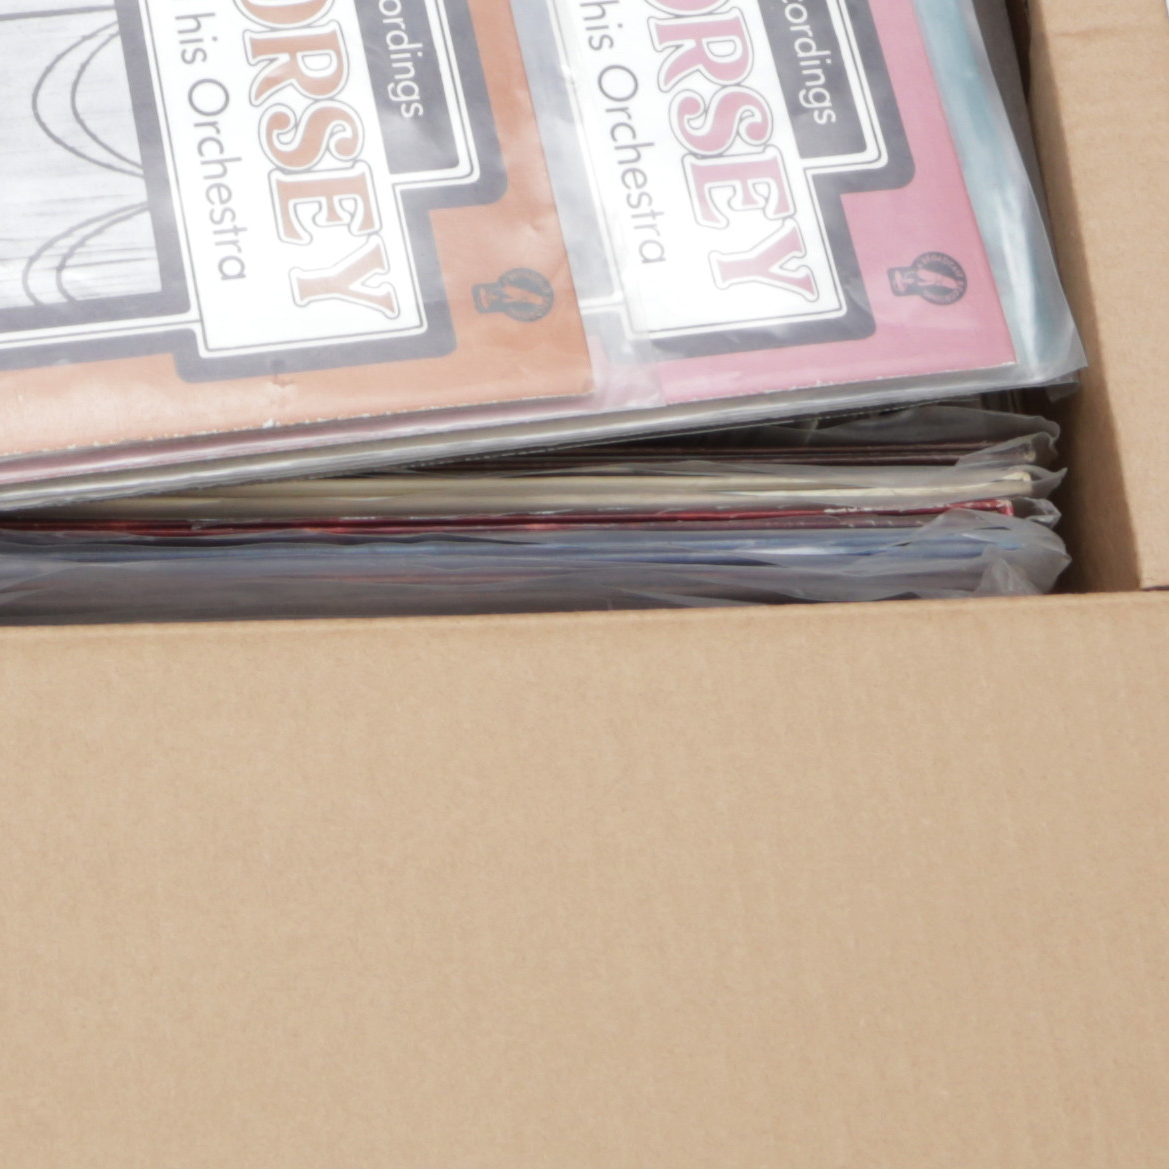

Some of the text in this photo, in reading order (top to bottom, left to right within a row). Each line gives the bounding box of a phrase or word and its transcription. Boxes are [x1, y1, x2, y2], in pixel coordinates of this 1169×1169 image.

[174, 12, 217, 65] his
[187, 77, 247, 282] Orchestra
[597, 64, 665, 265] Orchestra
